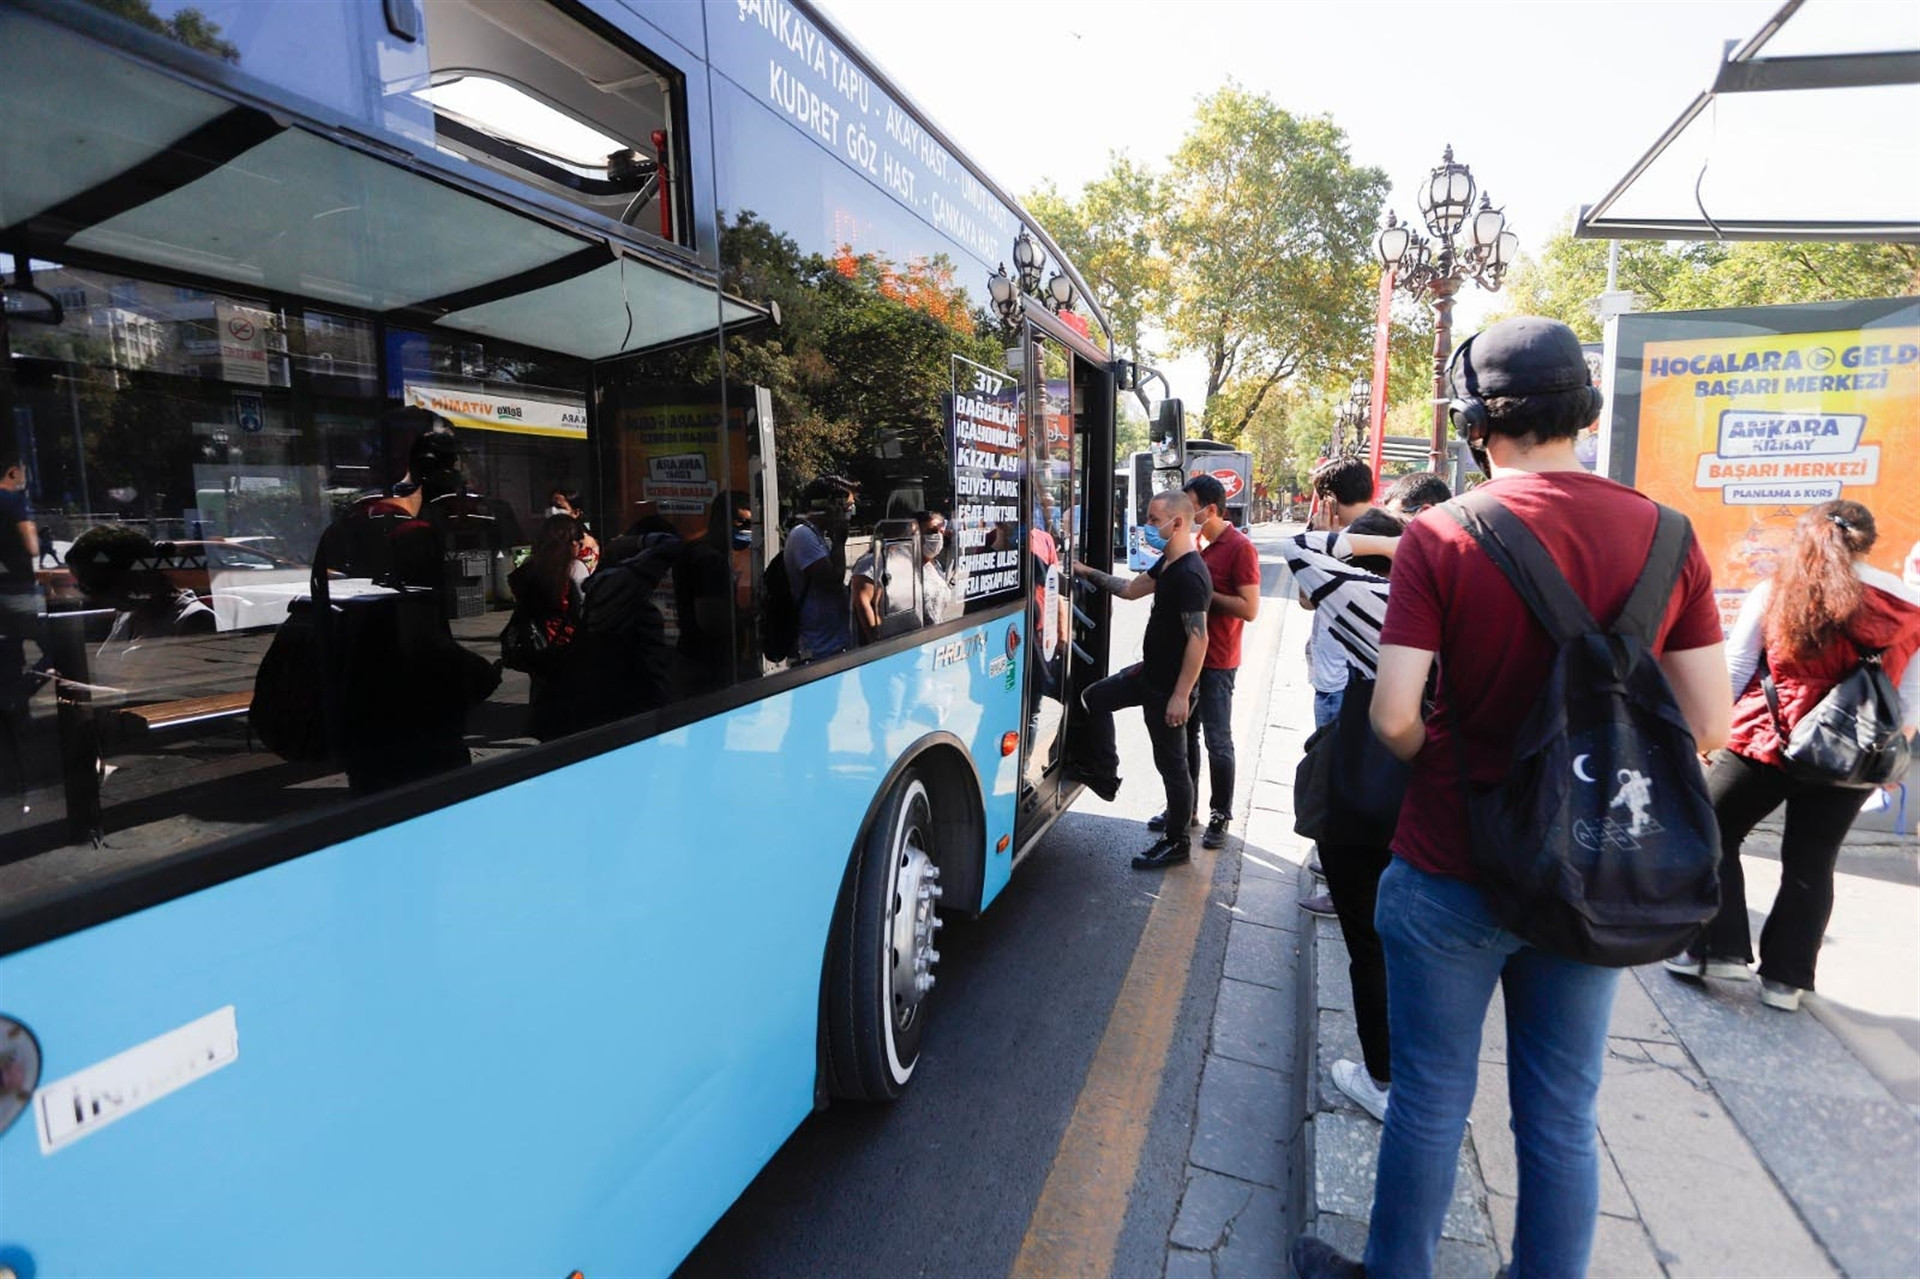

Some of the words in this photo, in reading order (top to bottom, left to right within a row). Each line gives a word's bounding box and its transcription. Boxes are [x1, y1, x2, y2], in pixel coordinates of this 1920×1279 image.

[830, 49, 868, 115] TAPU
[885, 105, 918, 155] AKAY
[770, 59, 839, 146] KUDRET
[846, 122, 878, 176] GÖZ
[931, 191, 977, 249] ÇANKAYA
[1650, 350, 1802, 377] HOCALARA
[974, 370, 1003, 396] 317
[1695, 378, 1779, 400] BAŞARI
[1784, 368, 1889, 393] MERKEZİ
[1728, 418, 1840, 438] ANKARA
[957, 447, 1018, 473] KIZILAY
[1708, 463, 1779, 481] BAŞARI
[1783, 459, 1868, 478] MERKEZİ
[958, 471, 993, 496] GÜVEN
[994, 479, 1018, 498] PARK
[1733, 489, 1791, 498] PLANLAMA
[1804, 488, 1833, 498] KURS
[996, 549, 1018, 569] ULUS
